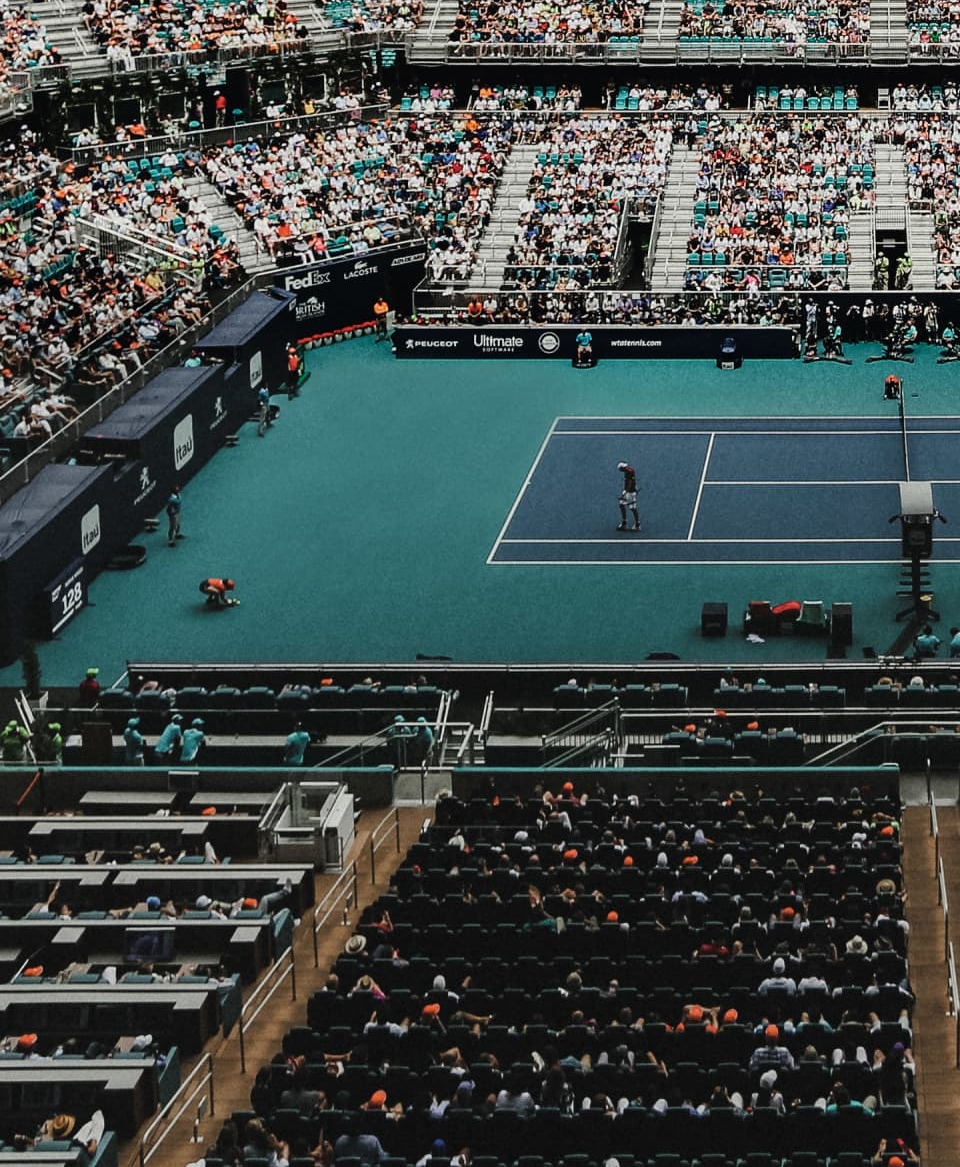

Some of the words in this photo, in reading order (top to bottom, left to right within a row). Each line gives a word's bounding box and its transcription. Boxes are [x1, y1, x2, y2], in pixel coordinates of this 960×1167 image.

[343, 266, 378, 280] LACOSTE
[285, 270, 331, 291] FedEx
[415, 340, 458, 348] PEUGEOT
[473, 334, 524, 348] Ultimate
[611, 339, 662, 347] wtatennis.com
[61, 581, 82, 615] 128
